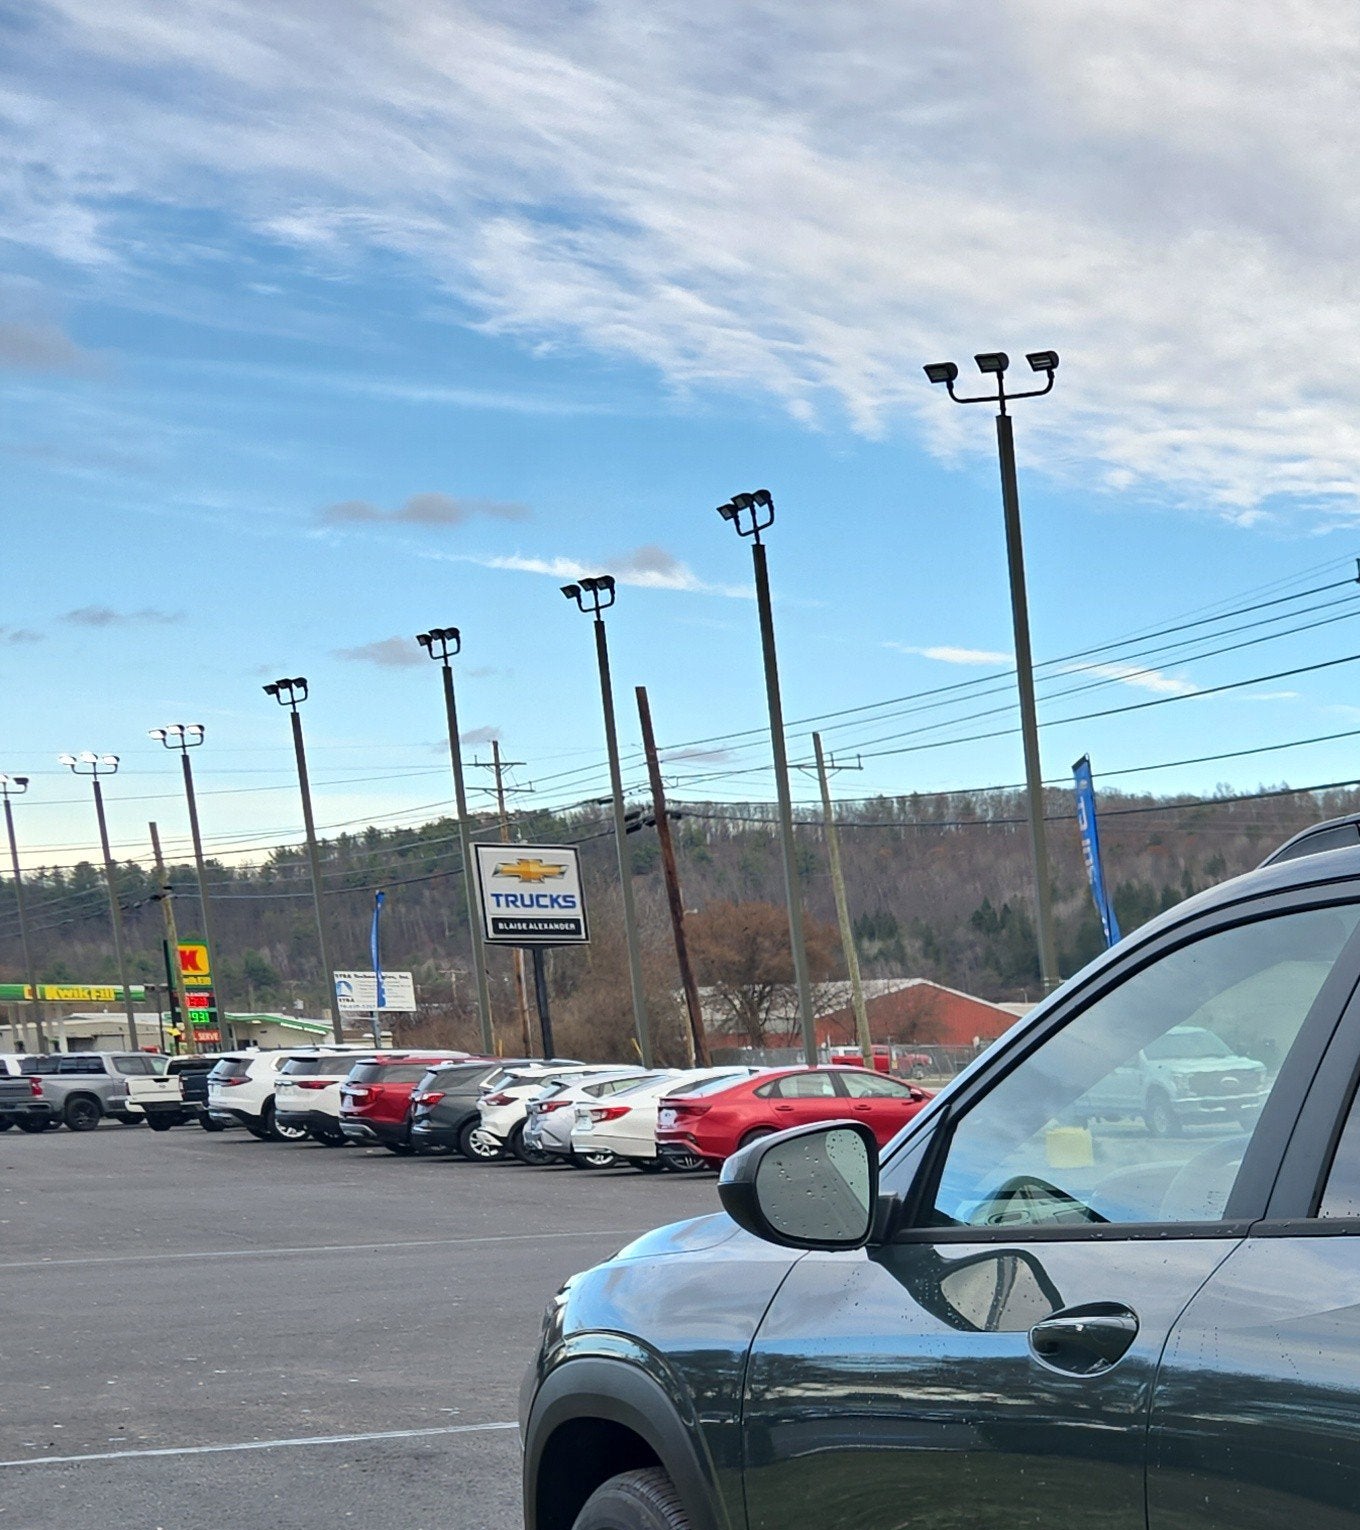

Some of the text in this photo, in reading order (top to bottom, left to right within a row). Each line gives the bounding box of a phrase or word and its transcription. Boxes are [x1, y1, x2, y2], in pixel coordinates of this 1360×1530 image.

[490, 893, 577, 909] TRUCKS
[498, 922, 577, 931] BLAISE ALEXANDER
[45, 985, 116, 1001] Kwik Fill
[198, 1031, 219, 1041] SERVE
